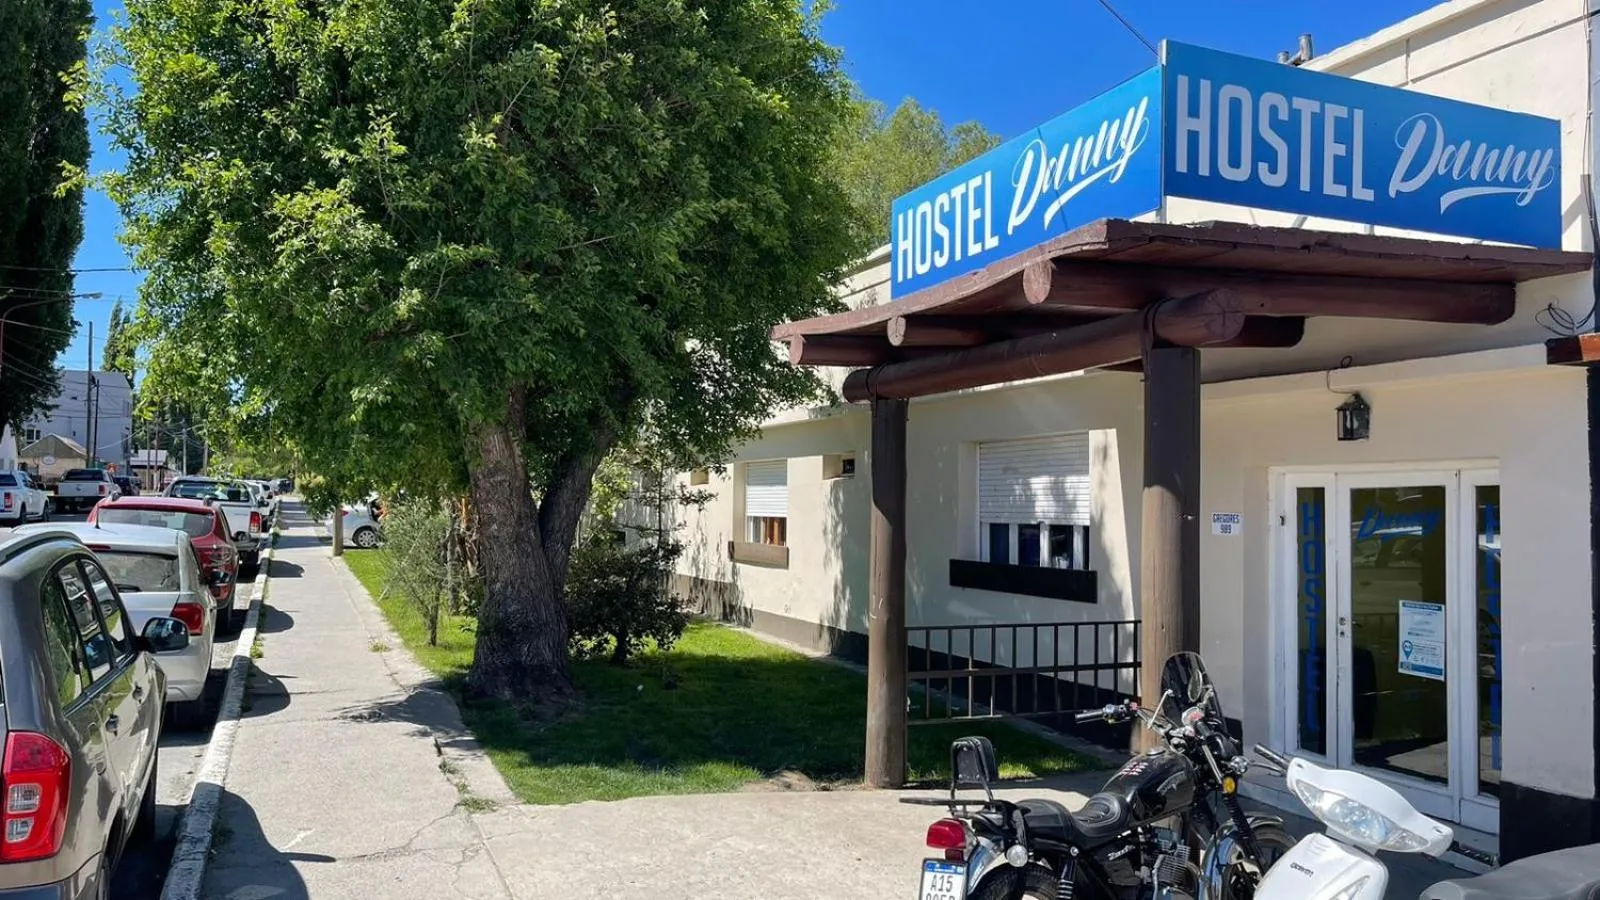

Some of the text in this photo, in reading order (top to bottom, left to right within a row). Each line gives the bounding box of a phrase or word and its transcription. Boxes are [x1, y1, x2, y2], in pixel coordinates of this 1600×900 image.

[897, 96, 1150, 283] HOSTEL Danny
[1174, 73, 1554, 215] HOSTEL Danny
[930, 874, 953, 892] A15
